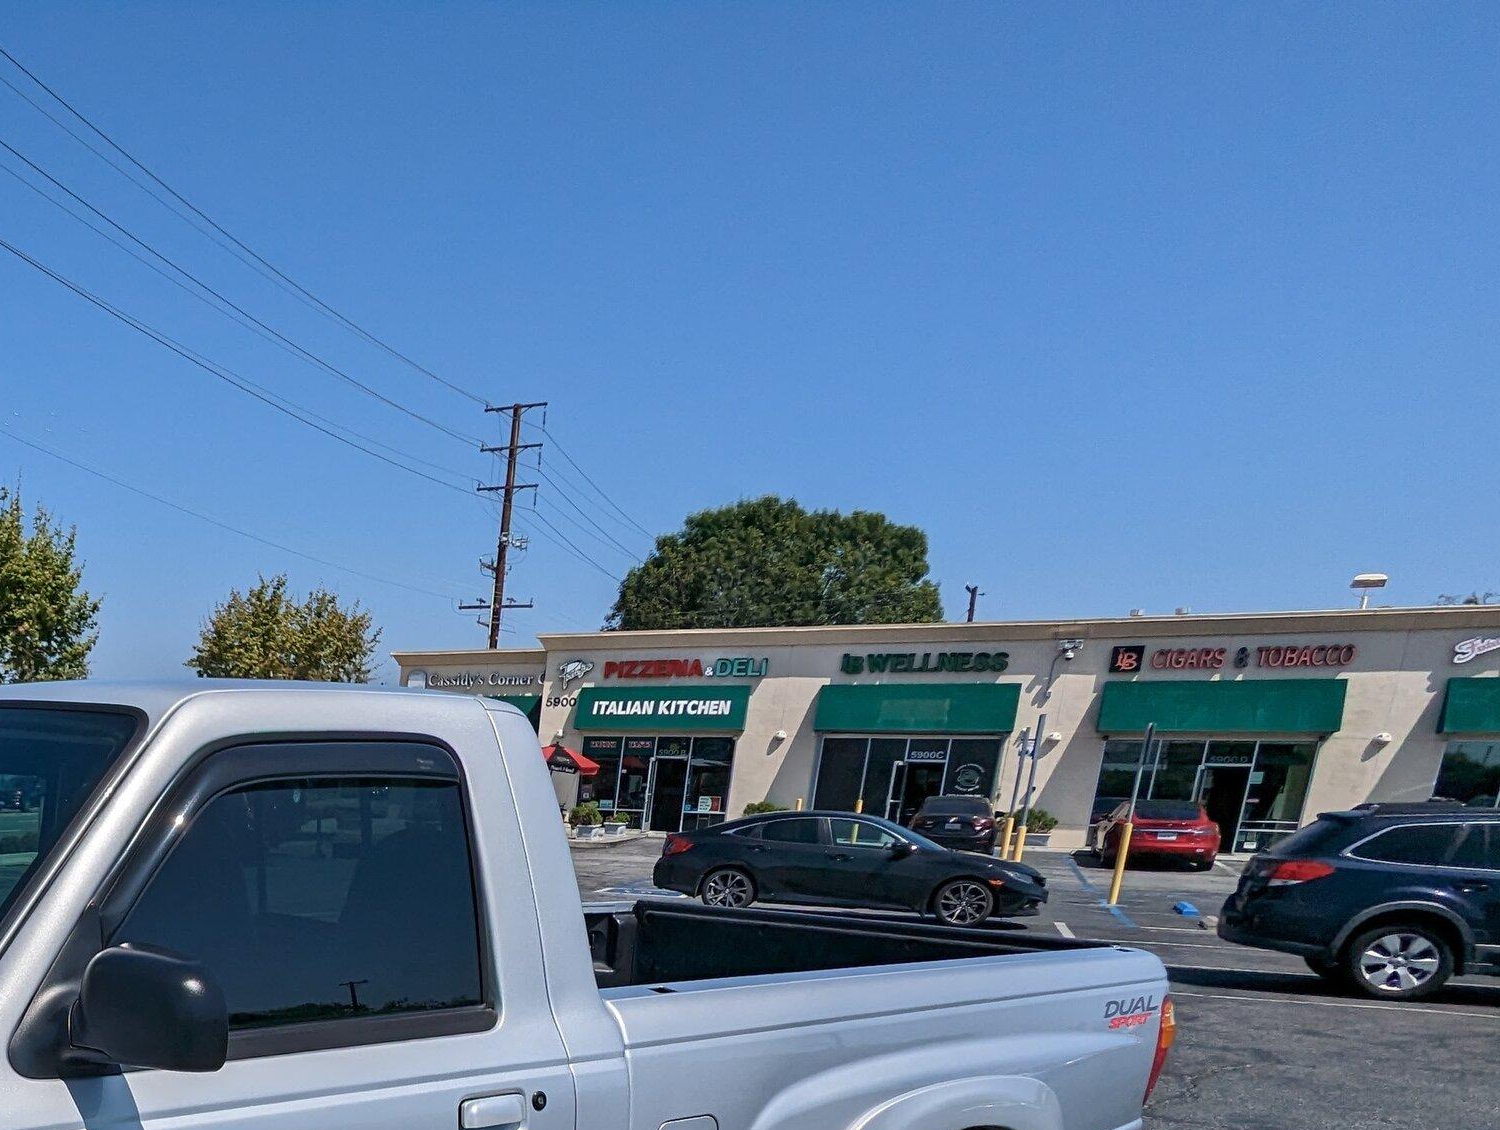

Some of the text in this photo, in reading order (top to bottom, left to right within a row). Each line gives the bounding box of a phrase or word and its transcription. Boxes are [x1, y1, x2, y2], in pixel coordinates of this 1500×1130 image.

[866, 651, 1010, 674] WELLNESS
[1151, 648, 1227, 670] CIGARS
[1234, 646, 1249, 669] &
[1256, 643, 1357, 668] TOBACCO
[603, 658, 704, 679] PIZZERIA
[704, 666, 715, 677] &
[714, 657, 769, 678] DELI
[428, 672, 485, 690] Cassidy's
[488, 672, 534, 687] Corner
[545, 697, 577, 708] 5900
[592, 699, 731, 716] ITALIAN KITCHEN
[910, 750, 945, 759] 5900C
[1104, 995, 1160, 1019] DUAL
[1108, 1012, 1153, 1030] SPORT
